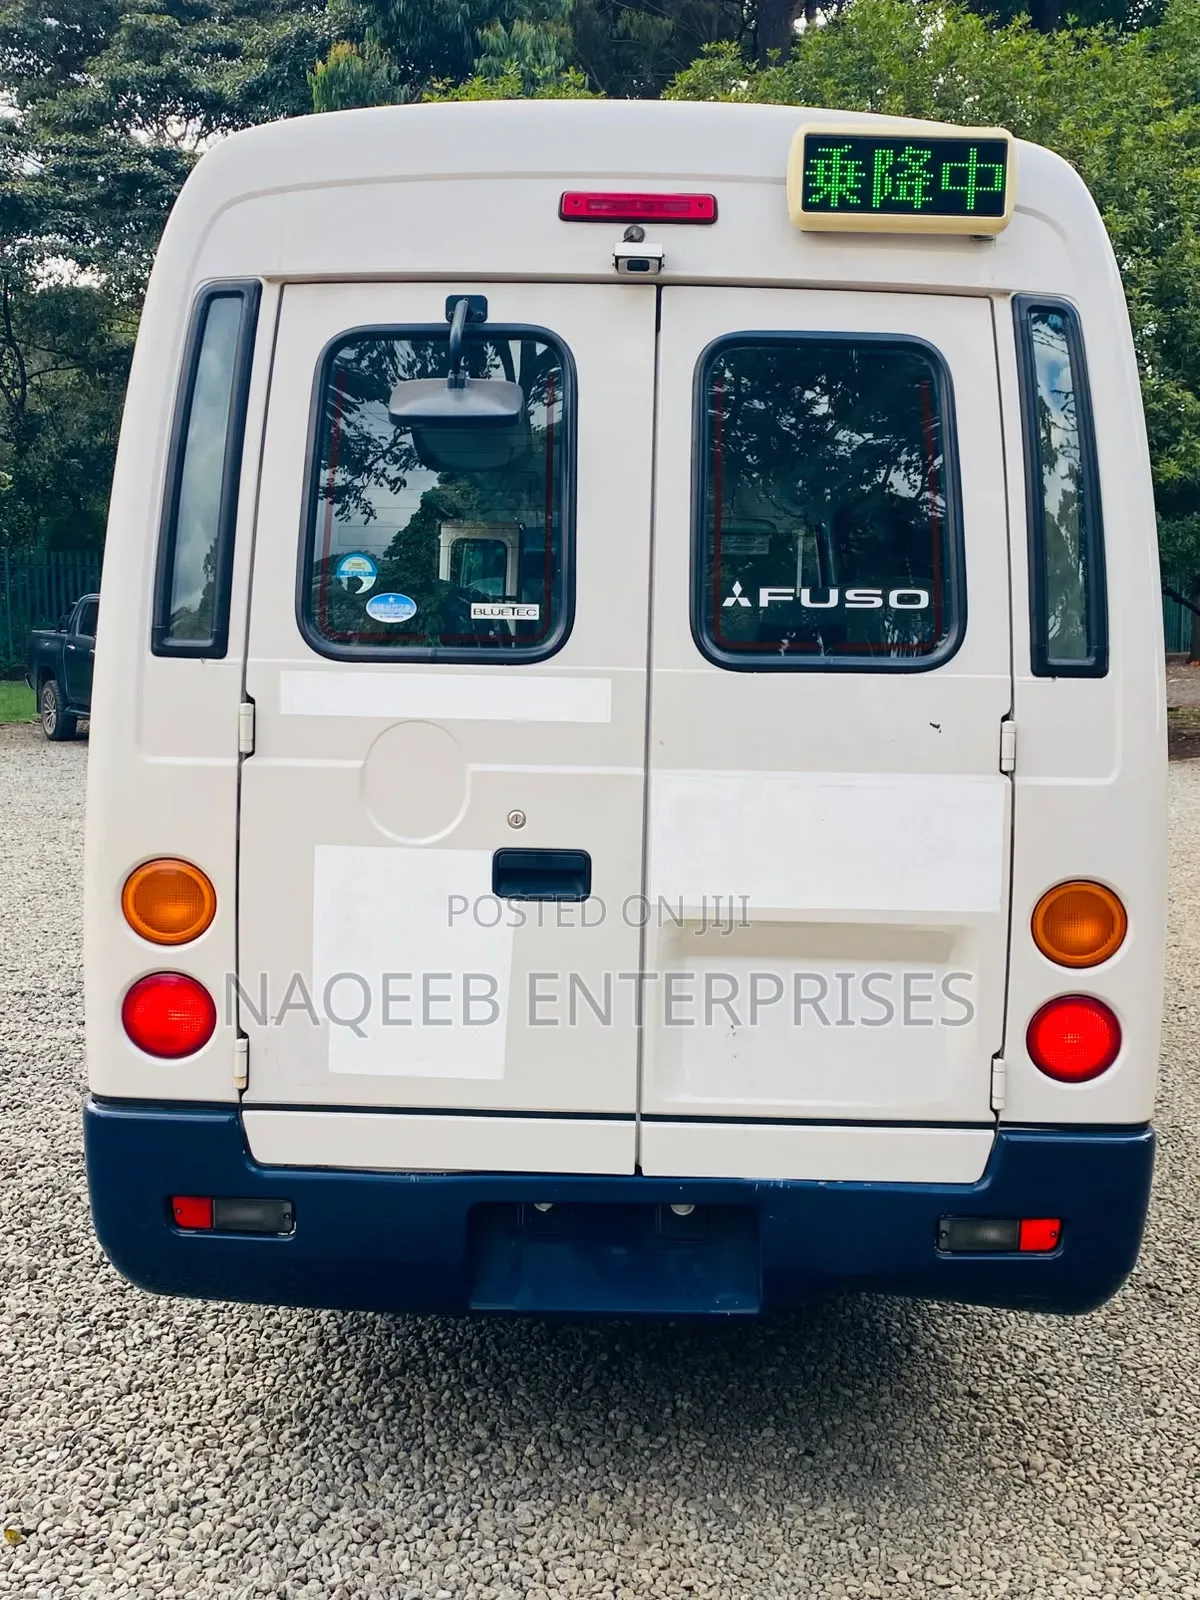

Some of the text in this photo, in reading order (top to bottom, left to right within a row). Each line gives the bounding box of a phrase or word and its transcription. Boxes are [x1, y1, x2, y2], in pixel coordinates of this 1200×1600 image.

[805, 145, 1003, 210] 乗降中
[759, 588, 930, 609] FUSO
[473, 607, 537, 617] BLUETEC
